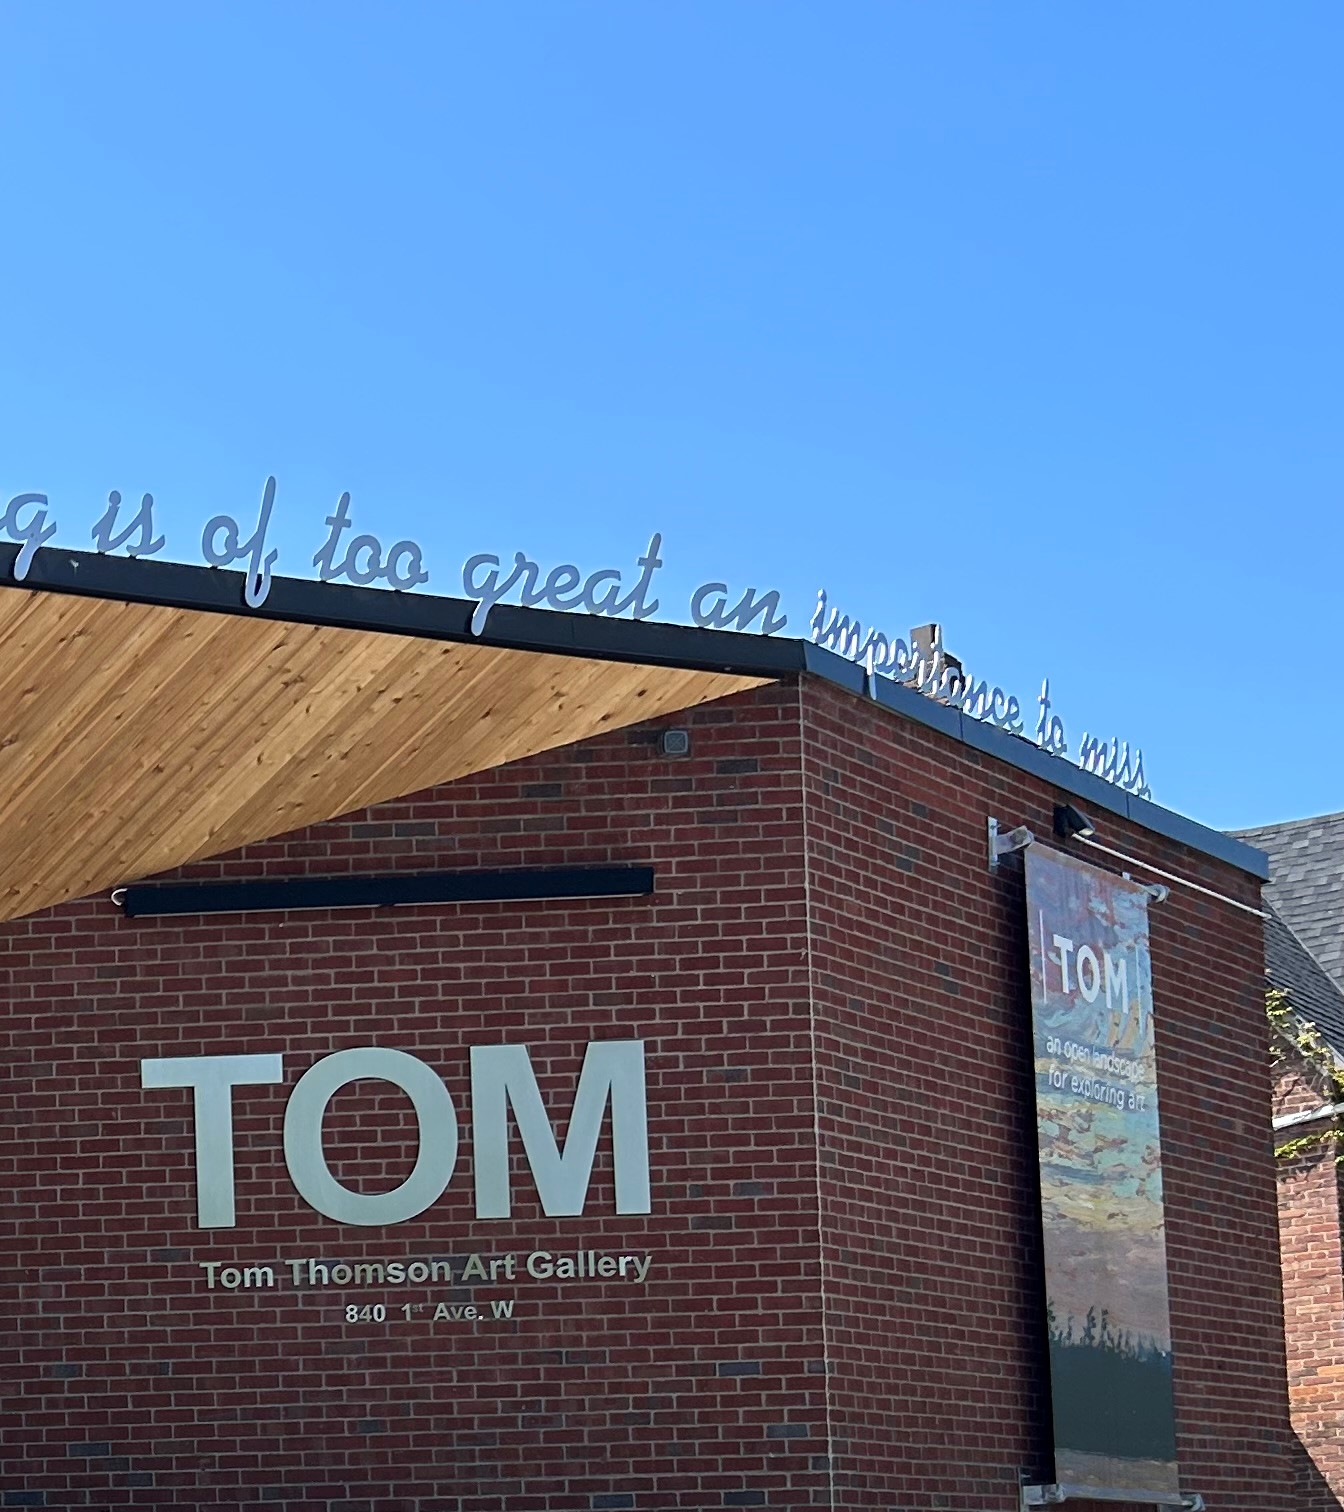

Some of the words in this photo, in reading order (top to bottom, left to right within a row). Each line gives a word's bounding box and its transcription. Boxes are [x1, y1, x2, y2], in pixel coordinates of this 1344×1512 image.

[91, 488, 165, 558] is
[202, 476, 277, 607] of
[313, 491, 429, 591] too
[463, 532, 664, 636] great
[690, 581, 787, 635] an
[810, 589, 1023, 735] importance
[1036, 678, 1068, 756] to
[1079, 732, 1151, 801] miss
[1053, 934, 1129, 1014] TOM
[1047, 1036, 1061, 1055] an
[1063, 1040, 1089, 1063] open
[1091, 1046, 1145, 1082] landscape
[1049, 1063, 1068, 1088] for
[1071, 1075, 1125, 1111] exploring
[141, 1040, 651, 1228] TOM
[199, 1261, 273, 1289] Tom
[286, 1257, 451, 1286] Thomson
[461, 1253, 515, 1281] Art
[526, 1250, 652, 1283] Gallery
[345, 1304, 386, 1323] 840
[433, 1302, 484, 1321] Ave.
[490, 1300, 514, 1320] W
